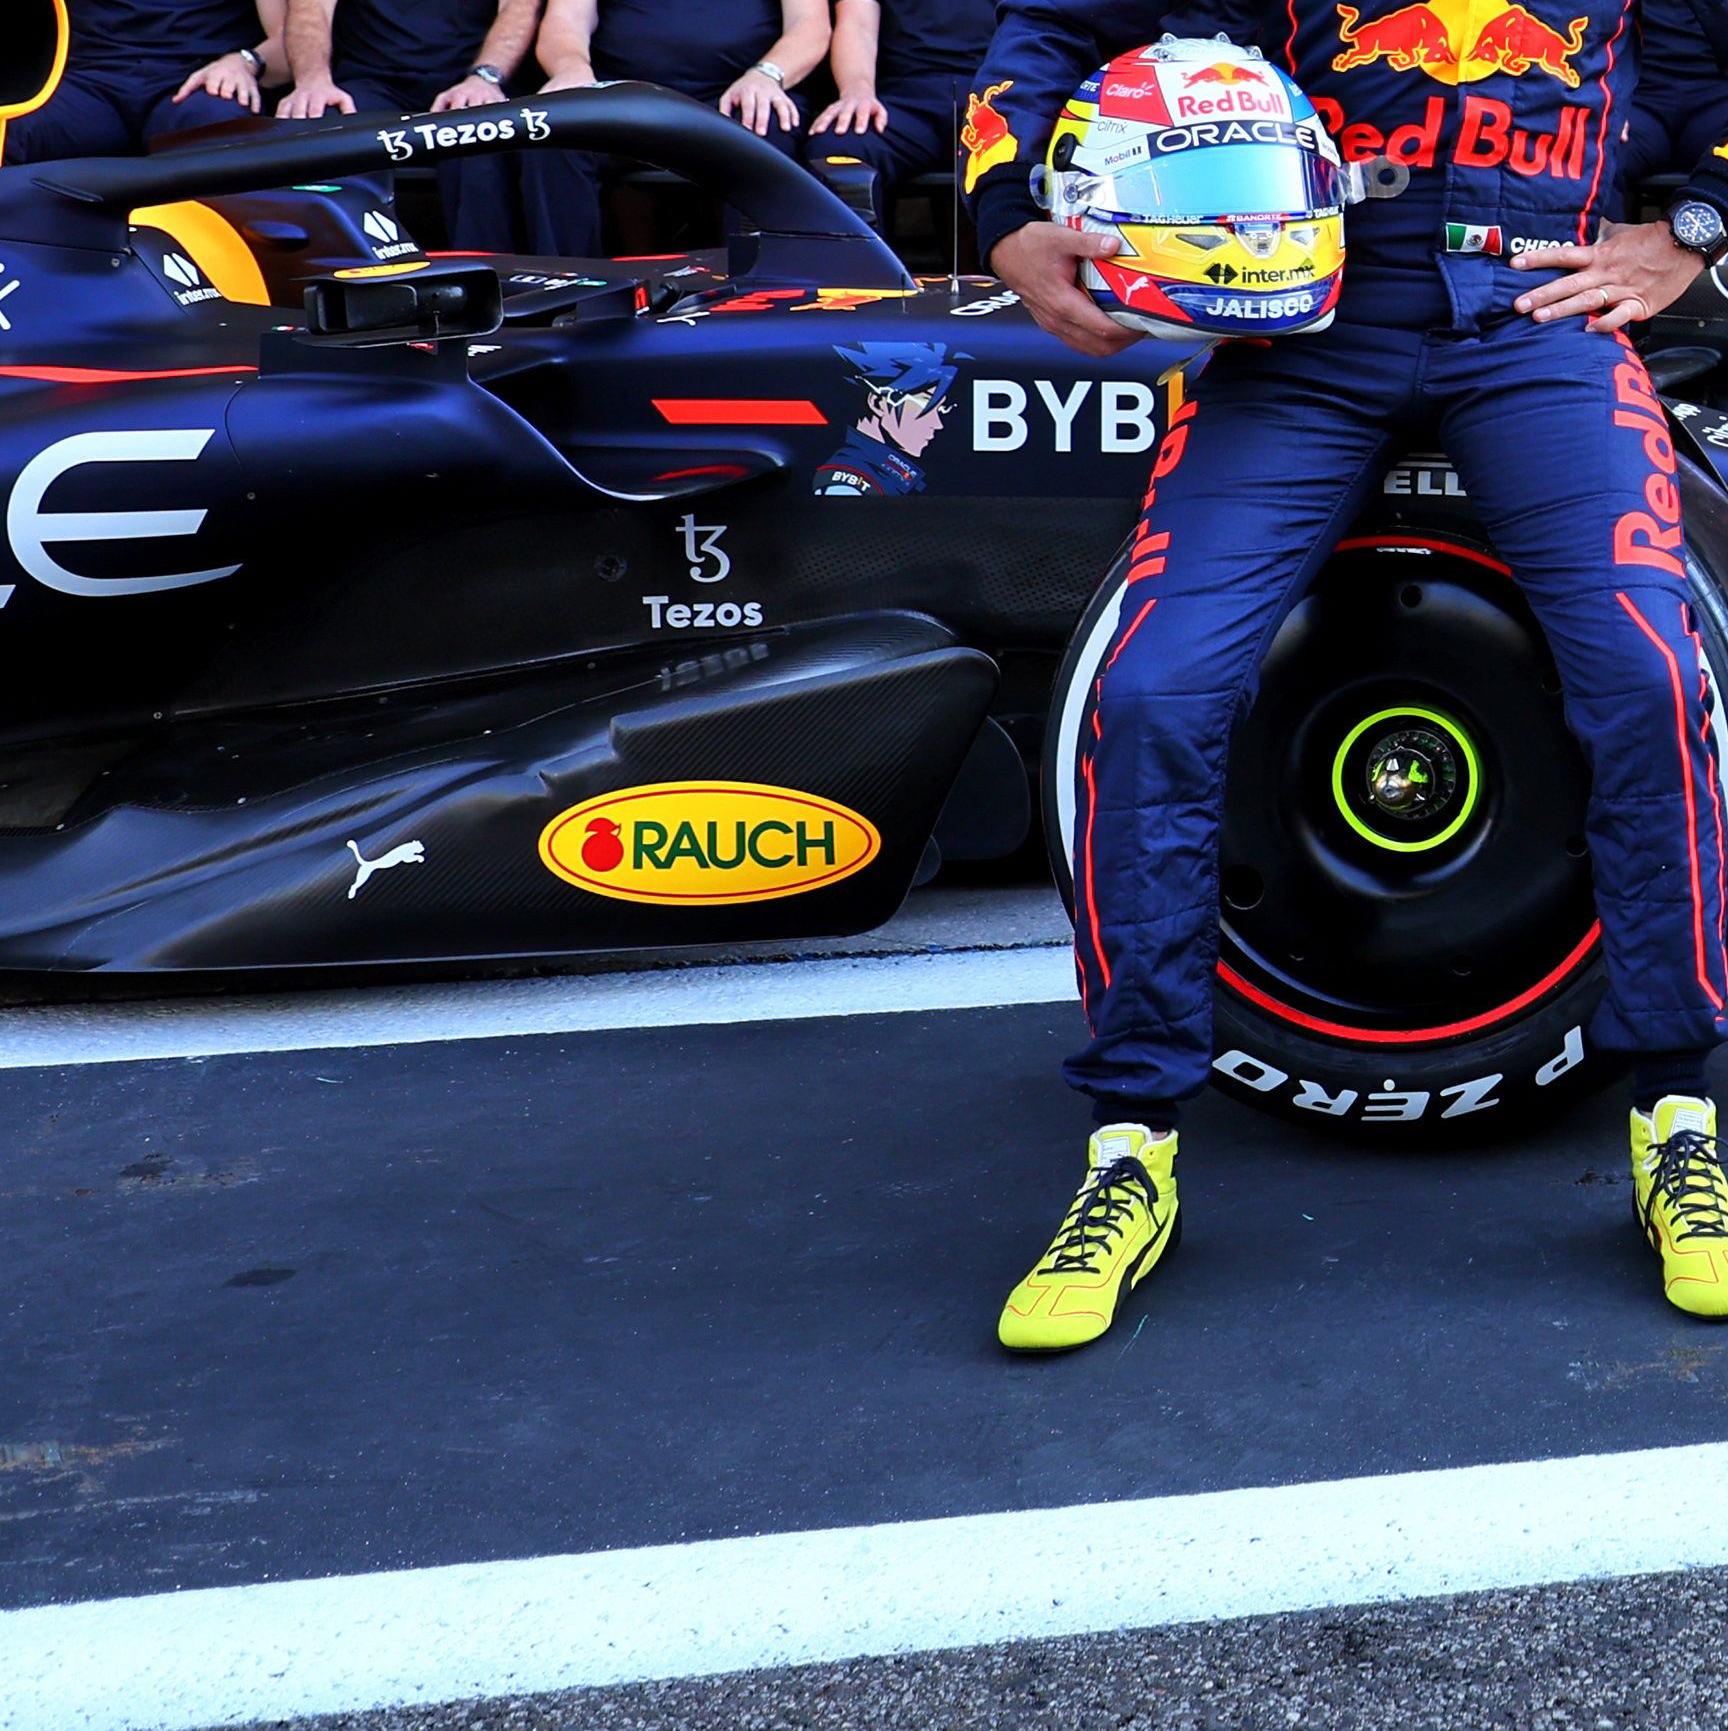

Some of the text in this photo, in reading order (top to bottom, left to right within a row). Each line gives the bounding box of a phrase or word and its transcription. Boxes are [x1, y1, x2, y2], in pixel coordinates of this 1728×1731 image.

[1106, 83, 1145, 99] Claro
[1177, 90, 1285, 118] Red Bull
[413, 117, 516, 150] Tezos
[1097, 119, 1128, 134] citrix
[1156, 121, 1315, 152] ORACLE
[1453, 96, 1591, 180] Bull
[1104, 149, 1131, 166] Mobil
[1241, 262, 1316, 284] inter.mx
[1206, 294, 1313, 319] JALISCO
[972, 371, 1185, 454] BYBI
[831, 470, 871, 493] BYBIT
[1613, 409, 1687, 578] Red
[642, 596, 763, 630] Tezos
[632, 819, 835, 871] RAUCH
[1212, 1049, 1504, 1122] ZERO
